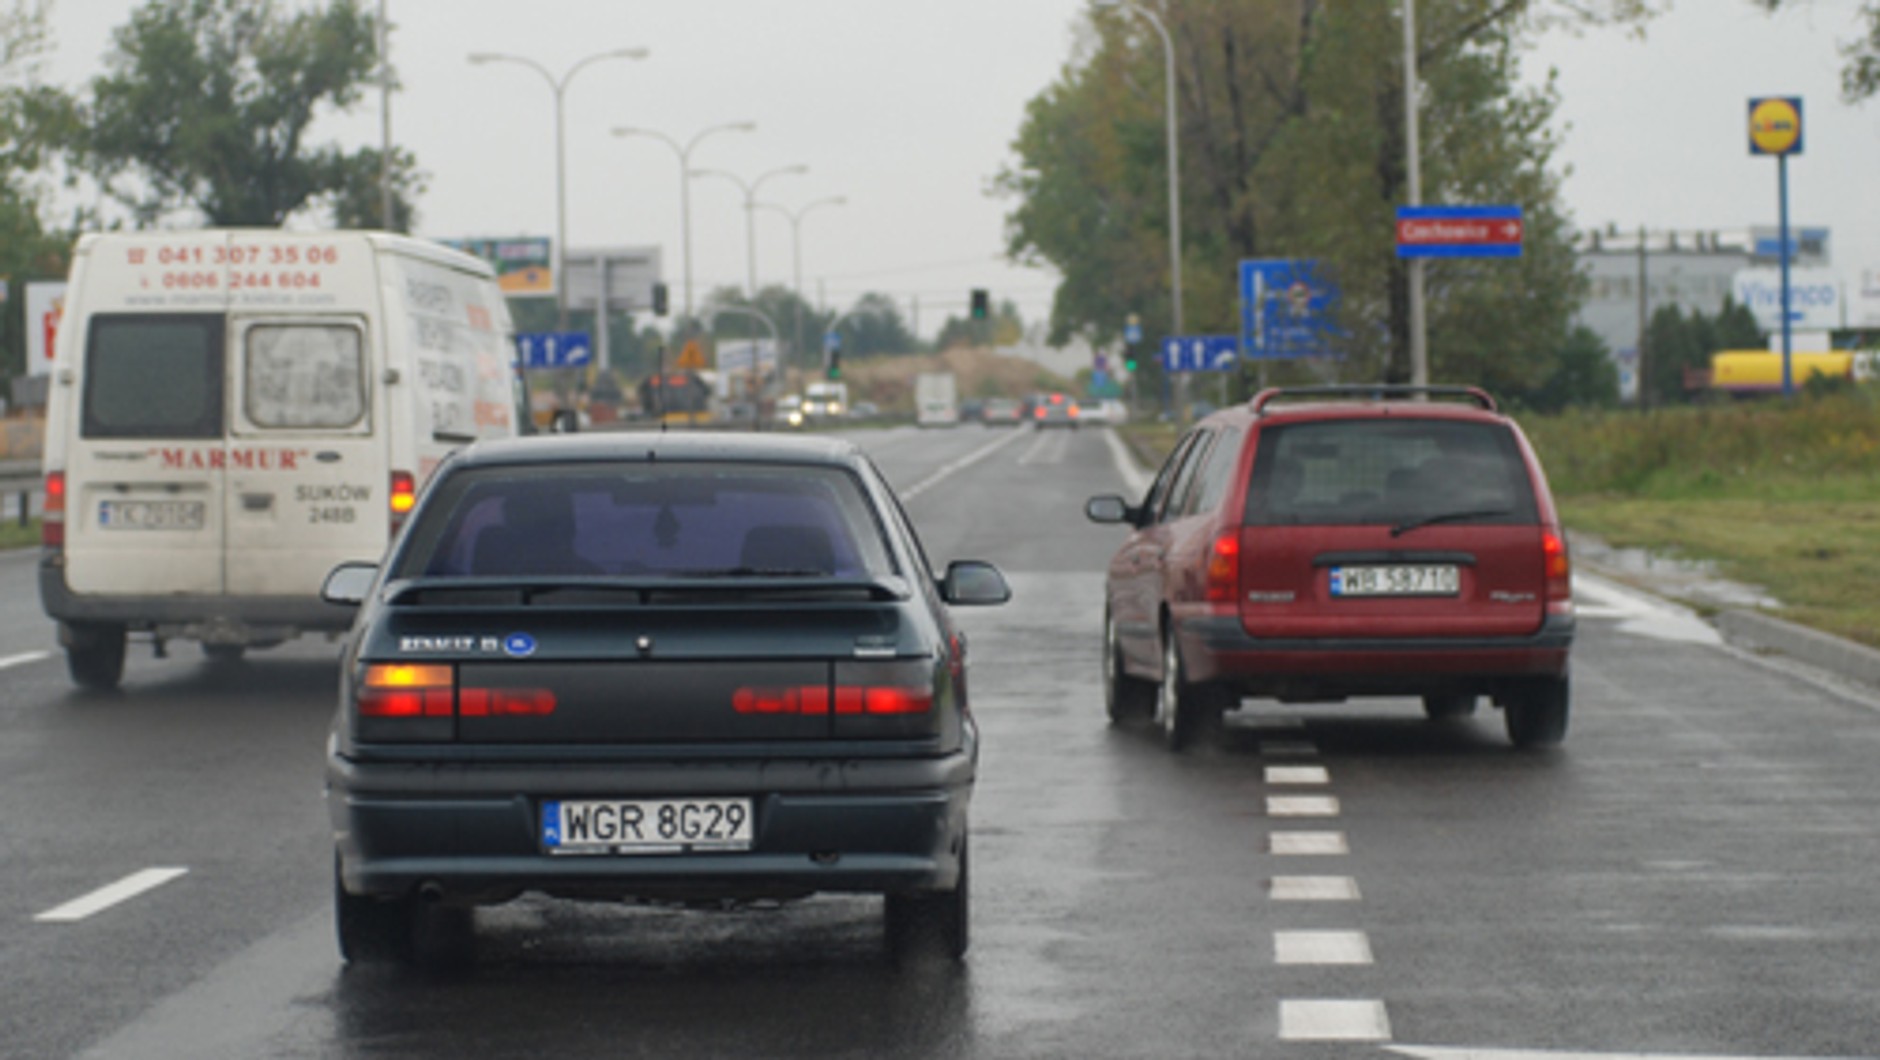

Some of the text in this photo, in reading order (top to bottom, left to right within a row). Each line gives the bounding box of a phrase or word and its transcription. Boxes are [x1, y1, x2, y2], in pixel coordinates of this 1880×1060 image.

[158, 246, 338, 264] 041 307 35 06
[229, 272, 271, 288] 244
[278, 272, 320, 288] 604
[1741, 281, 1835, 306] Vivnco
[148, 448, 309, 469] "MARMUR"
[566, 803, 746, 840] WGR 8G29
